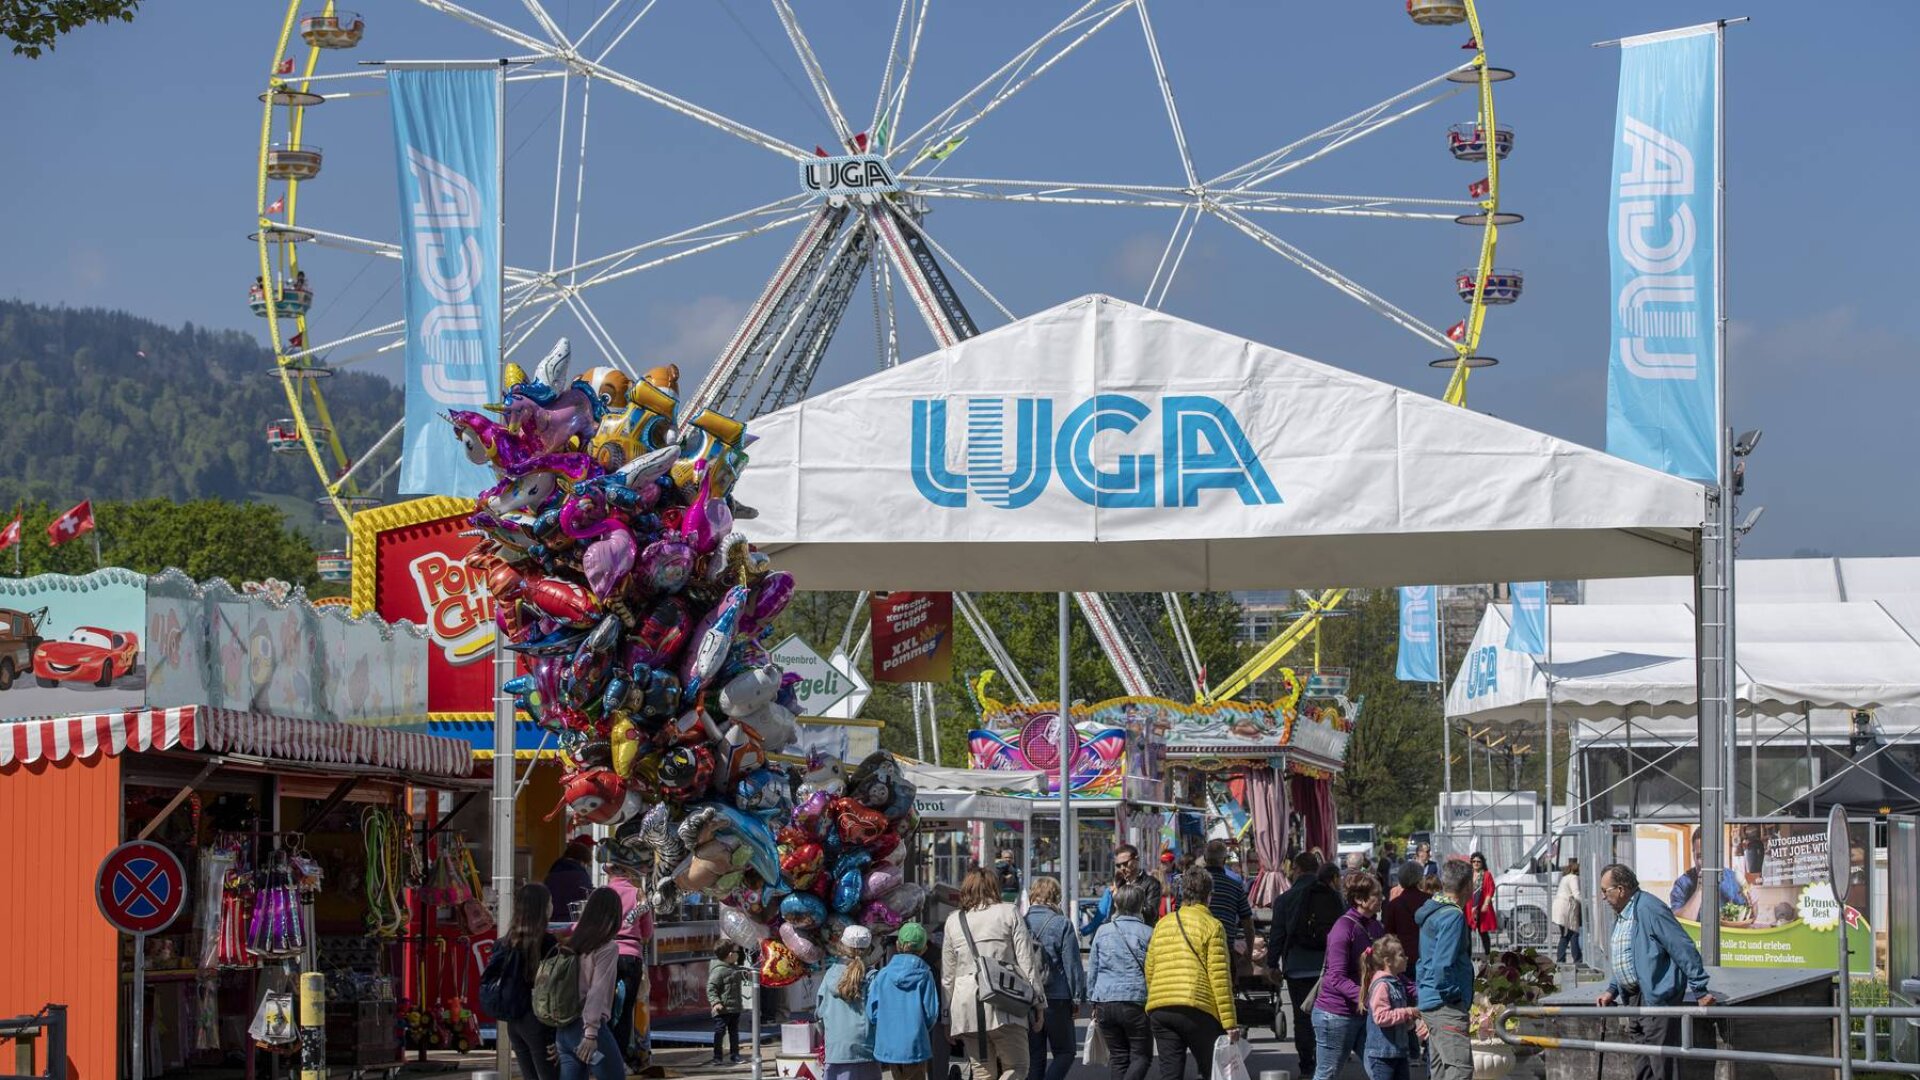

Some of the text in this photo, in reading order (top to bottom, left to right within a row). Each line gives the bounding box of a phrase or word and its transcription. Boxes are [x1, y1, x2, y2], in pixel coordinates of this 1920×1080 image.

[806, 160, 893, 190] LUGA
[911, 393, 1285, 510] LUGA
[416, 556, 492, 606] POM
[893, 611, 927, 633] Chips
[892, 636, 919, 657] XXL
[773, 653, 817, 665] Magenbrot
[1454, 808, 1470, 817] WC
[1768, 832, 1828, 847] AUTOGRAMMSTU
[1771, 847, 1788, 858] MIT
[1789, 844, 1811, 857] JOEL
[1804, 896, 1838, 908] Bruno
[1812, 907, 1830, 918] Best
[1748, 940, 1762, 950] und
[1763, 940, 1791, 951] erleben
[1734, 953, 1764, 961] unseren
